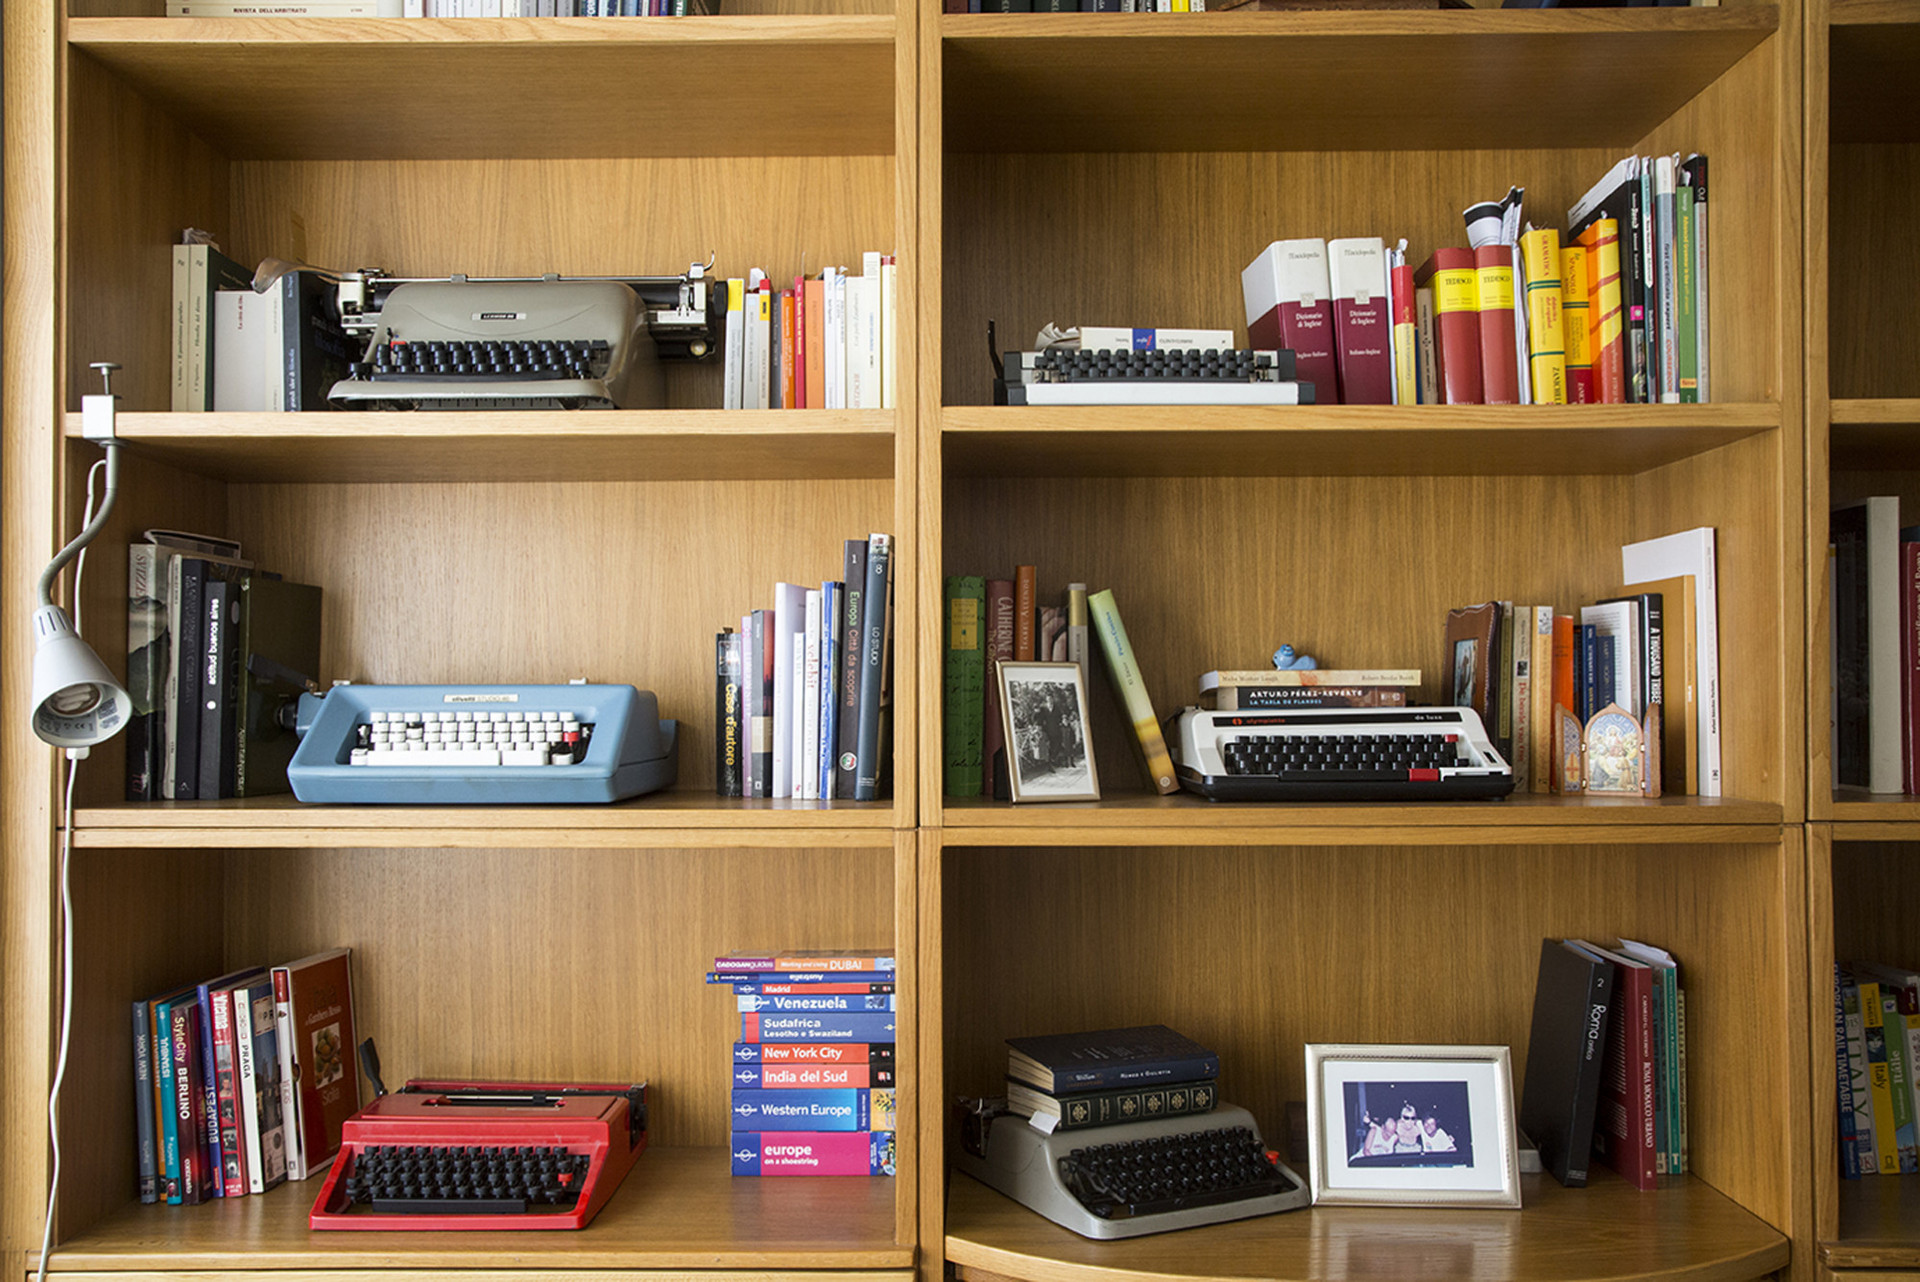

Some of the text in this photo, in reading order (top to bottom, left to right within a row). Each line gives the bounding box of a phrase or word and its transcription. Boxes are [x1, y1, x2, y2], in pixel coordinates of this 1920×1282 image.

[1445, 278, 1472, 286] TEDESCO
[1483, 275, 1510, 284] TEDESCO
[1664, 302, 1672, 330] expert
[1666, 339, 1674, 392] COURSEBOOK
[875, 563, 883, 575] 8
[997, 596, 1014, 653] CATHERINE
[1020, 579, 1030, 650] ISABEL ALLENDE
[207, 598, 219, 685] actitud buenos aires
[845, 591, 860, 707] Europa Città da scoprire
[869, 626, 880, 666] LO STUDIO
[1650, 635, 1661, 676] THOUSAND
[1248, 690, 1288, 699] ARTURO
[724, 683, 738, 766] Case d'autore
[829, 960, 862, 970] DUBAI
[764, 985, 791, 993] Madrid
[1597, 977, 1605, 989] 2
[774, 996, 848, 1009] Venezuela
[764, 1018, 821, 1028] Sudafrica
[764, 1029, 799, 1038] Lesotho
[808, 1029, 853, 1038] Swaziland
[1588, 1004, 1607, 1040] Roma
[1836, 1027, 1848, 1050] RAIL
[136, 1033, 147, 1080] NEW YORK
[160, 1036, 170, 1078] ISTANBUL
[174, 1016, 191, 1120] StyleCity BERLINO
[241, 1044, 251, 1079] PRAGA
[764, 1047, 843, 1060] New York City
[1892, 1050, 1904, 1083] Itálie
[764, 1070, 848, 1083] India del Sud
[1643, 1061, 1652, 1083] ROMA
[1838, 1052, 1852, 1113] TIMETABLE
[1848, 1037, 1869, 1118] ITALY
[1874, 1064, 1887, 1090] Italy
[206, 1086, 219, 1144] BUDAPEST
[762, 1104, 852, 1118] Western Europe
[1643, 1084, 1652, 1117] MOSAICO
[1644, 1118, 1654, 1148] URBANO
[764, 1145, 812, 1157] europe
[780, 1157, 819, 1167] shoestring
